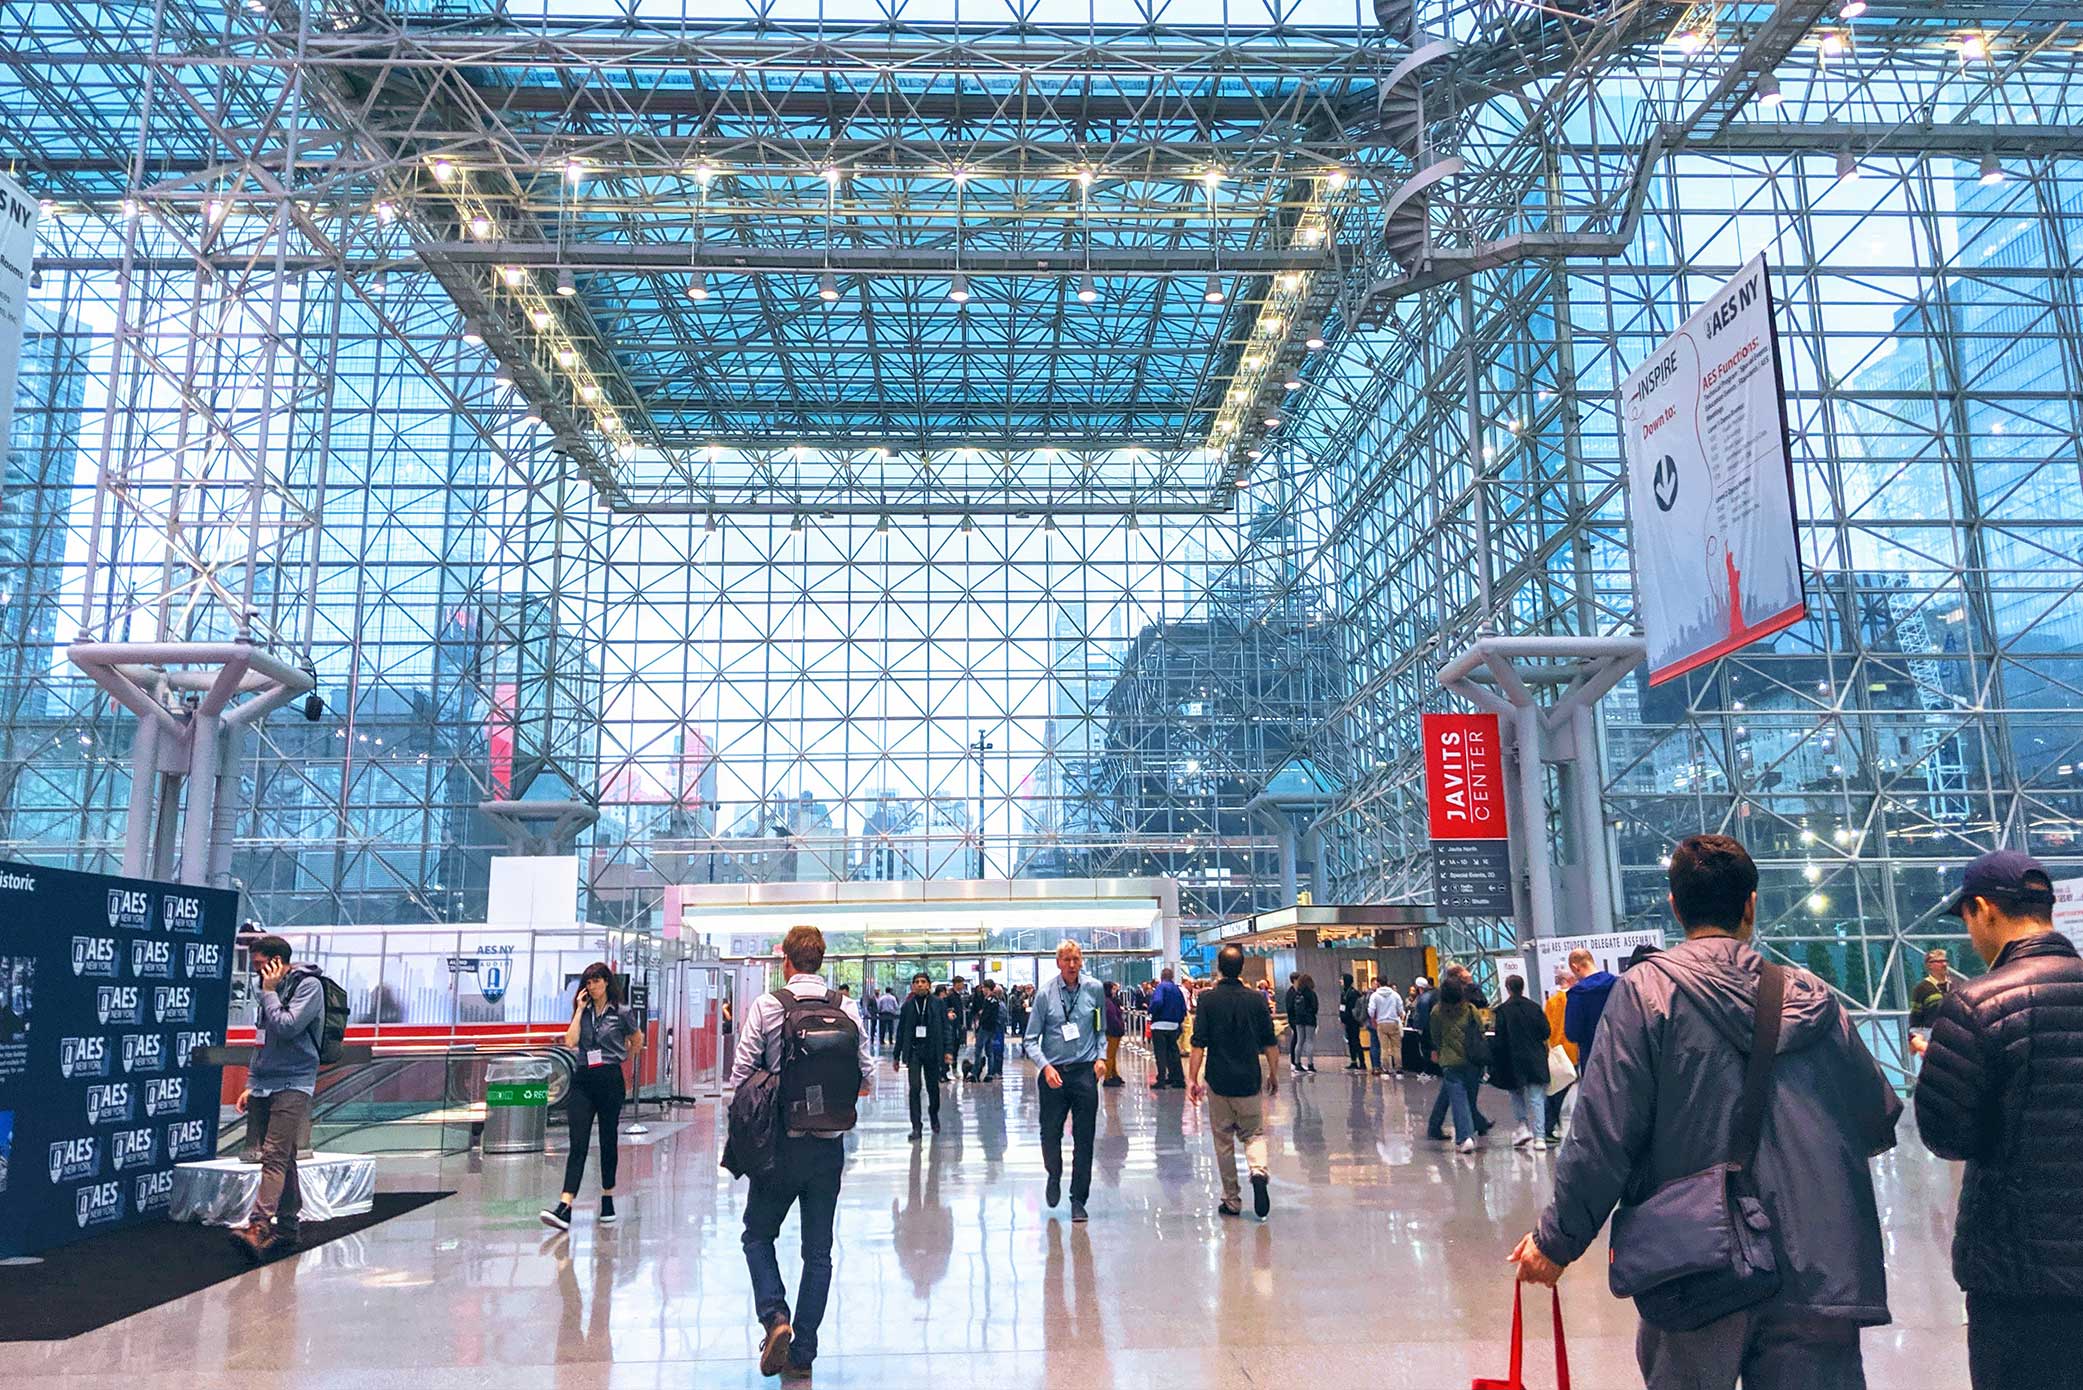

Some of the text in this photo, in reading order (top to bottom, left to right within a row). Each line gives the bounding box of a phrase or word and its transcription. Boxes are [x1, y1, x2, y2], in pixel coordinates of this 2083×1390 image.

[10, 197, 32, 228] NY
[0, 254, 23, 279] Rooms
[1713, 274, 1758, 336] AES NY
[1638, 350, 1677, 401] INSPIRE
[1702, 336, 1759, 392] AES Functions:
[1643, 404, 1676, 440] Down to:
[1441, 732, 1467, 820] JAVITS
[1469, 731, 1490, 820] CENTER
[0, 870, 35, 891] istoric
[121, 891, 147, 914] AES
[175, 897, 199, 918] AES
[86, 938, 114, 961] AES
[145, 941, 169, 963] AES
[196, 944, 219, 964] AES
[477, 945, 515, 954] AES NY
[1552, 942, 1561, 952] AES
[1563, 940, 1587, 951] STUDENT
[1590, 937, 1620, 950] DELEGATE
[1623, 935, 1657, 947] ASSEMBLY
[111, 986, 138, 1008] AES
[167, 987, 190, 1008] AES
[76, 1037, 105, 1060] AES
[136, 1034, 160, 1056] AES
[101, 1083, 128, 1107] AES
[158, 1078, 182, 1100] AES
[126, 1128, 152, 1153] AES
[180, 1120, 203, 1145] AES
[65, 1137, 94, 1164] AES
[148, 1169, 173, 1195] AES
[91, 1181, 118, 1208] AES
